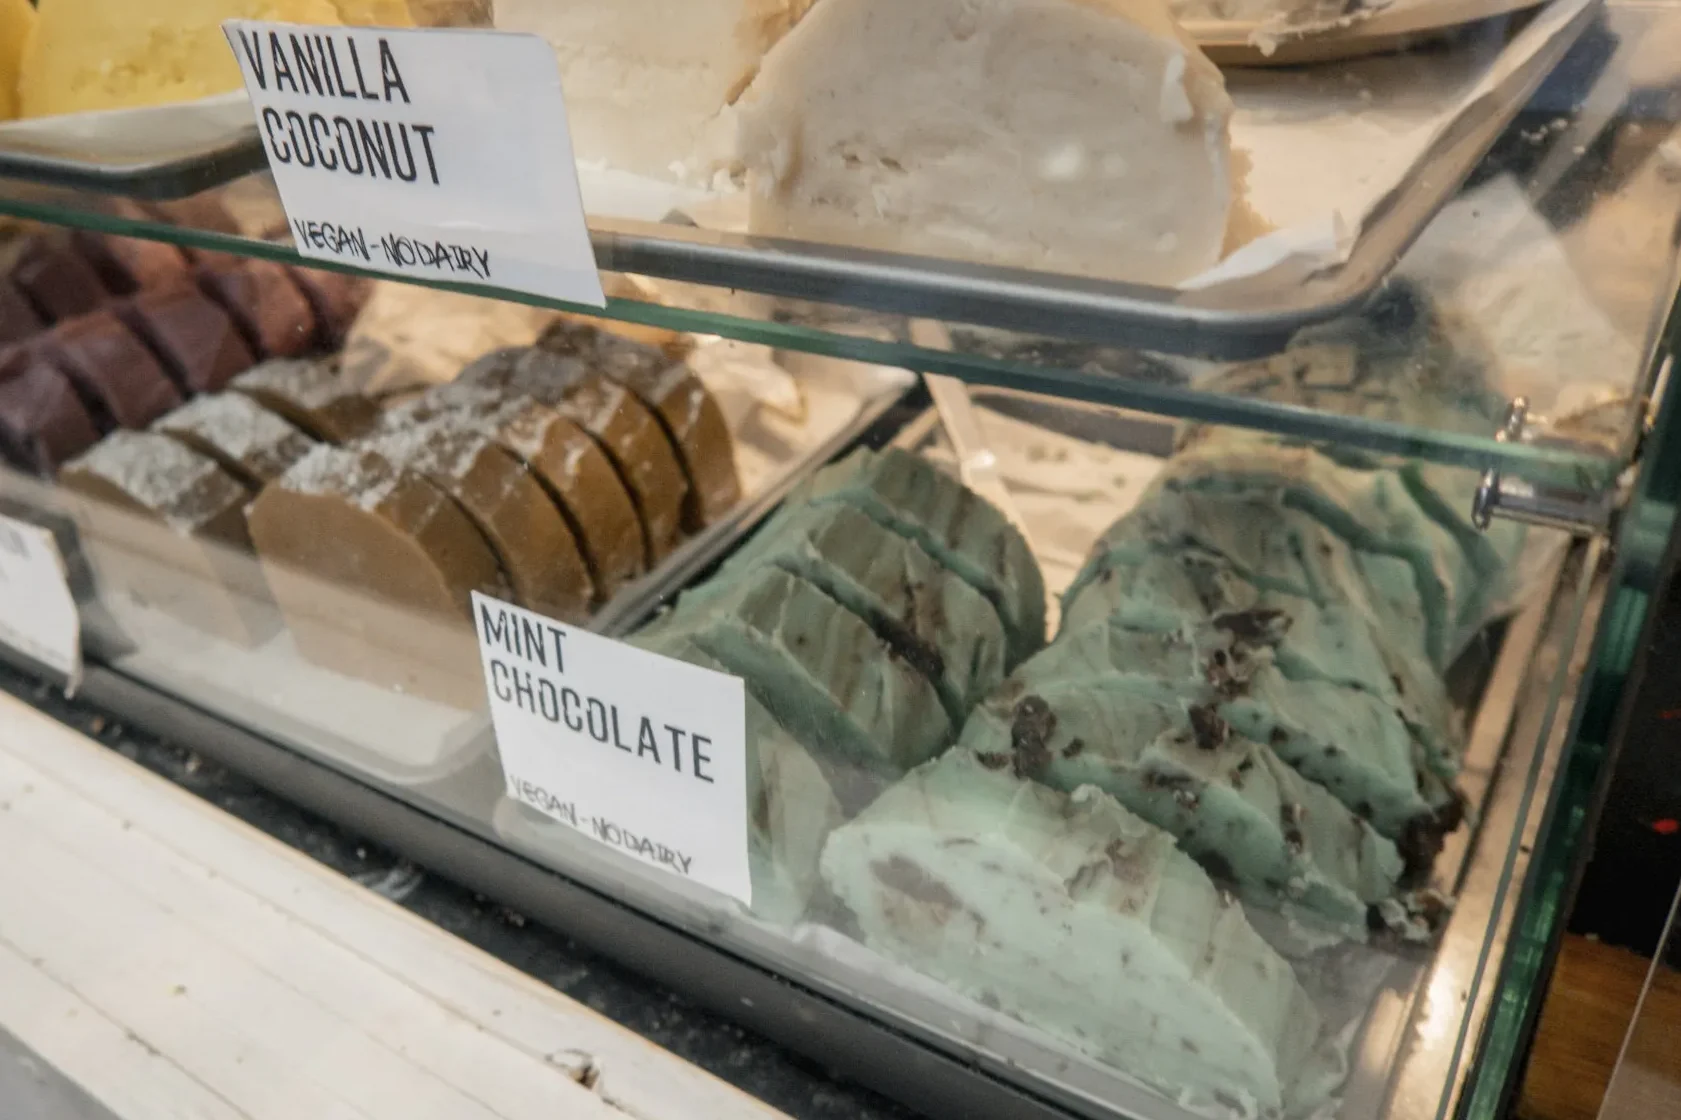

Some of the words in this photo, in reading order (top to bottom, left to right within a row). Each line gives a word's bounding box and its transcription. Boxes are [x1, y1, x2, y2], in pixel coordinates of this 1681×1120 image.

[238, 29, 411, 104] VANILLA
[262, 106, 440, 185] COCONUT
[481, 603, 567, 674] MINT
[490, 659, 715, 784] CHOCOLATE
